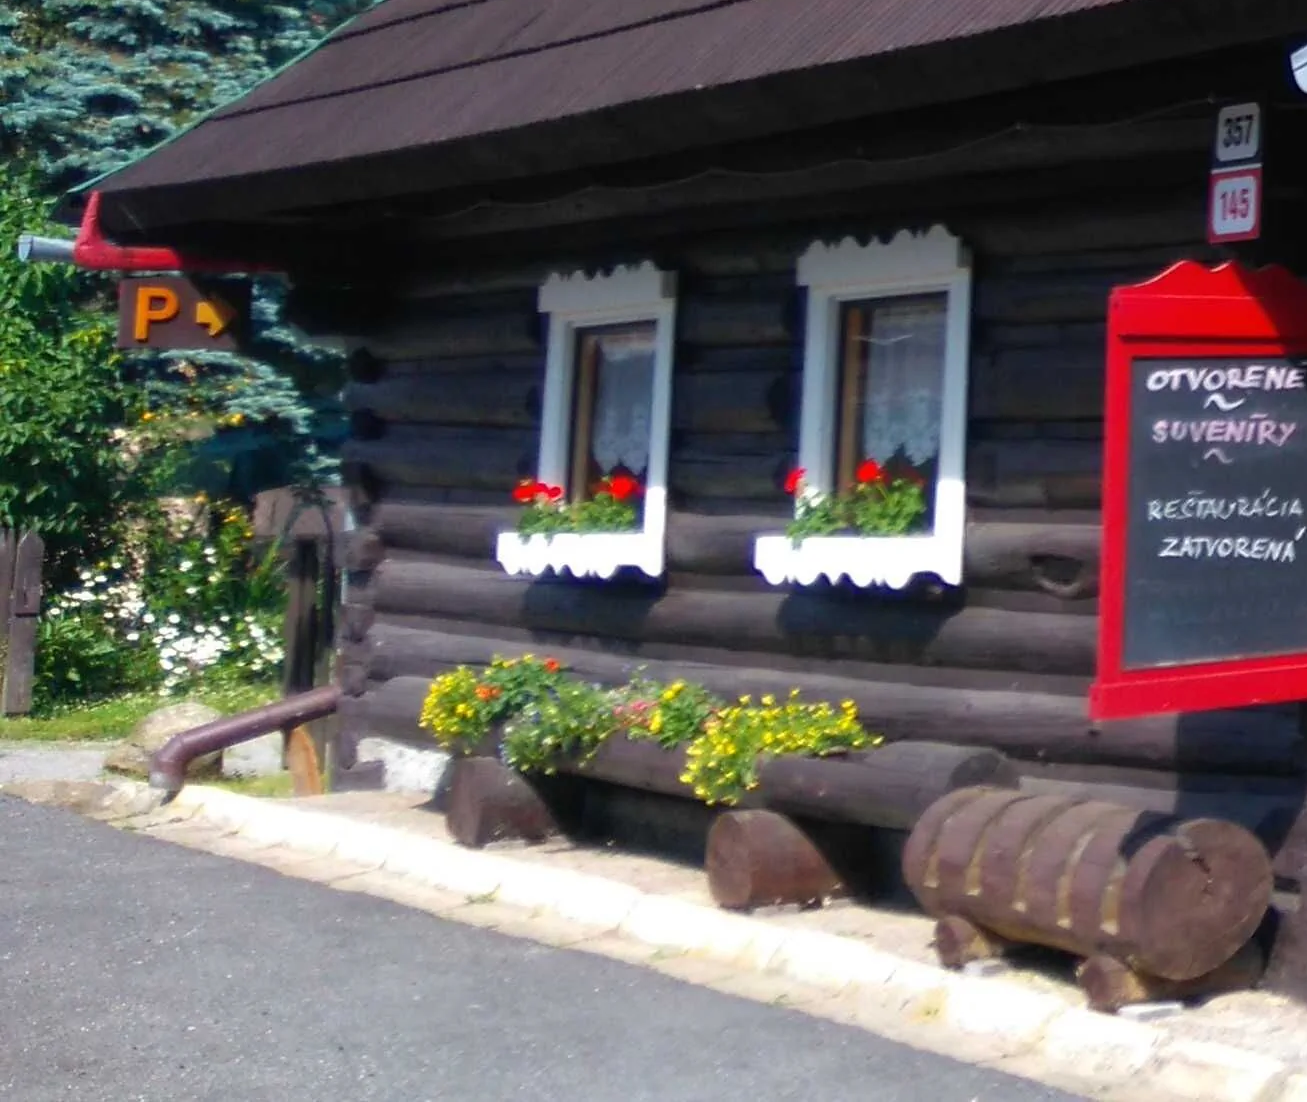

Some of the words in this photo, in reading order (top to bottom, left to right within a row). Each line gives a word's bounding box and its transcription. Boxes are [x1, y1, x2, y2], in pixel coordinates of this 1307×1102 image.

[1223, 113, 1254, 148] 357
[1219, 188, 1250, 221] 145
[134, 285, 180, 342] P
[1157, 526, 1306, 562] ZATVORENÁ
